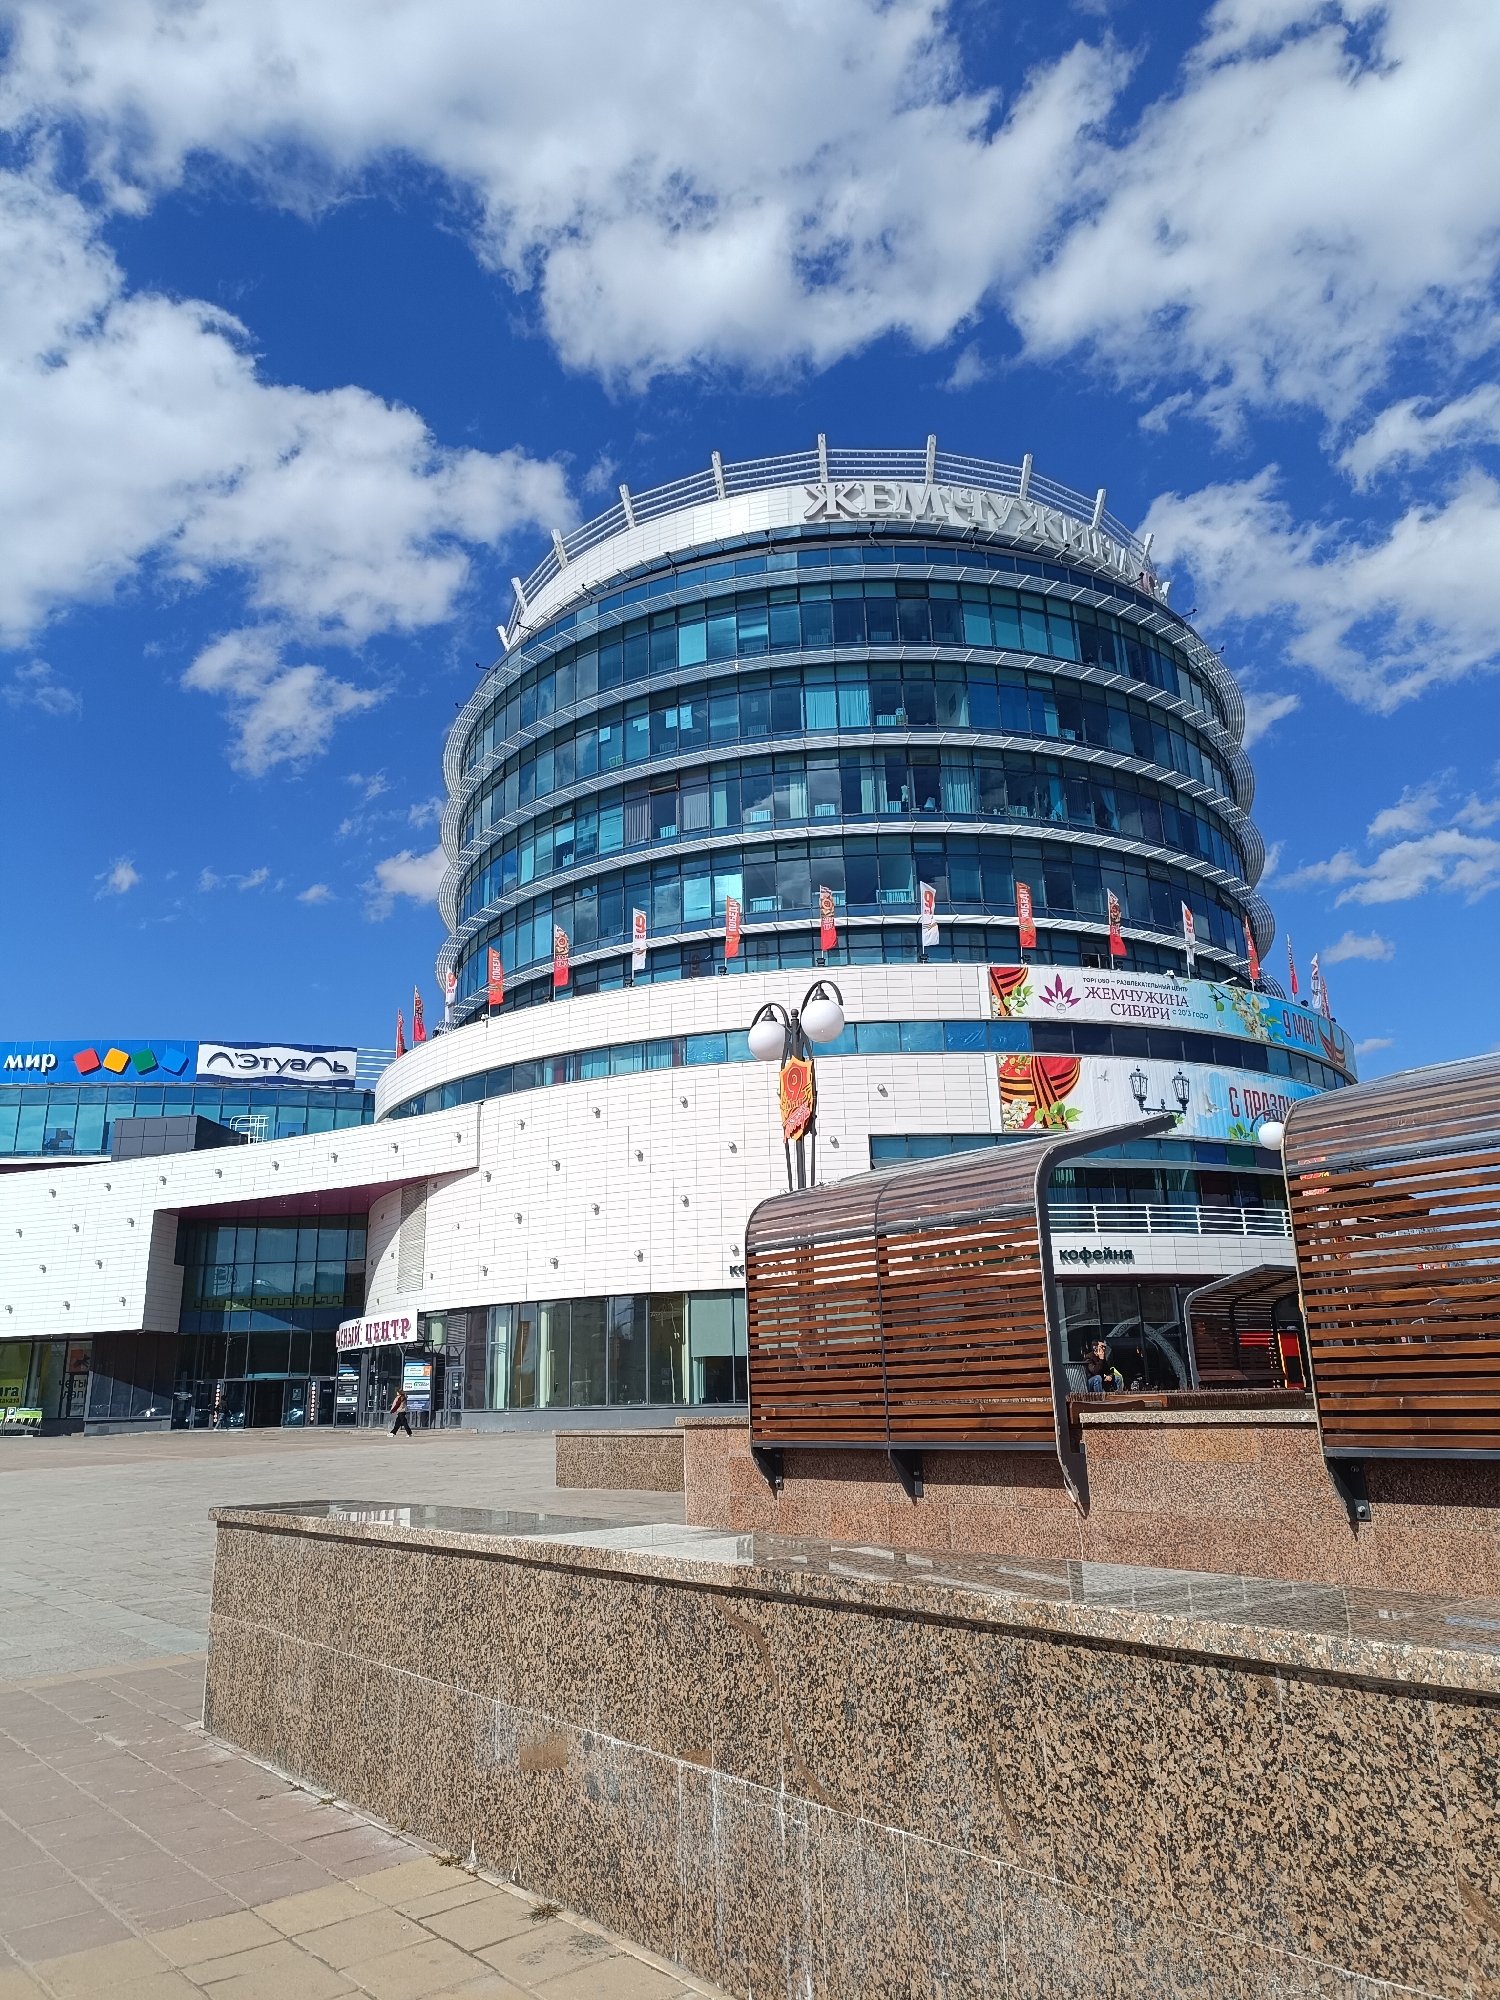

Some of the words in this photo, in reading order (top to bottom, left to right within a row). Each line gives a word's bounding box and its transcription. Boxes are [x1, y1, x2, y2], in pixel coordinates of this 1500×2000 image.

[803, 482, 1138, 578] ЖЕМЧУЖИНА
[635, 915, 645, 933] 9
[1084, 986, 1189, 1008] ЖЕМЧУЖИНА
[1110, 1003, 1171, 1020] СИБИРИ
[1282, 1010, 1292, 1038] 9
[1292, 1013, 1317, 1046] МАЯ
[3, 1051, 57, 1075] мир
[1228, 1086, 1240, 1117] С
[1059, 1246, 1134, 1264] кофейня
[365, 1318, 411, 1343] ЦЕНТР
